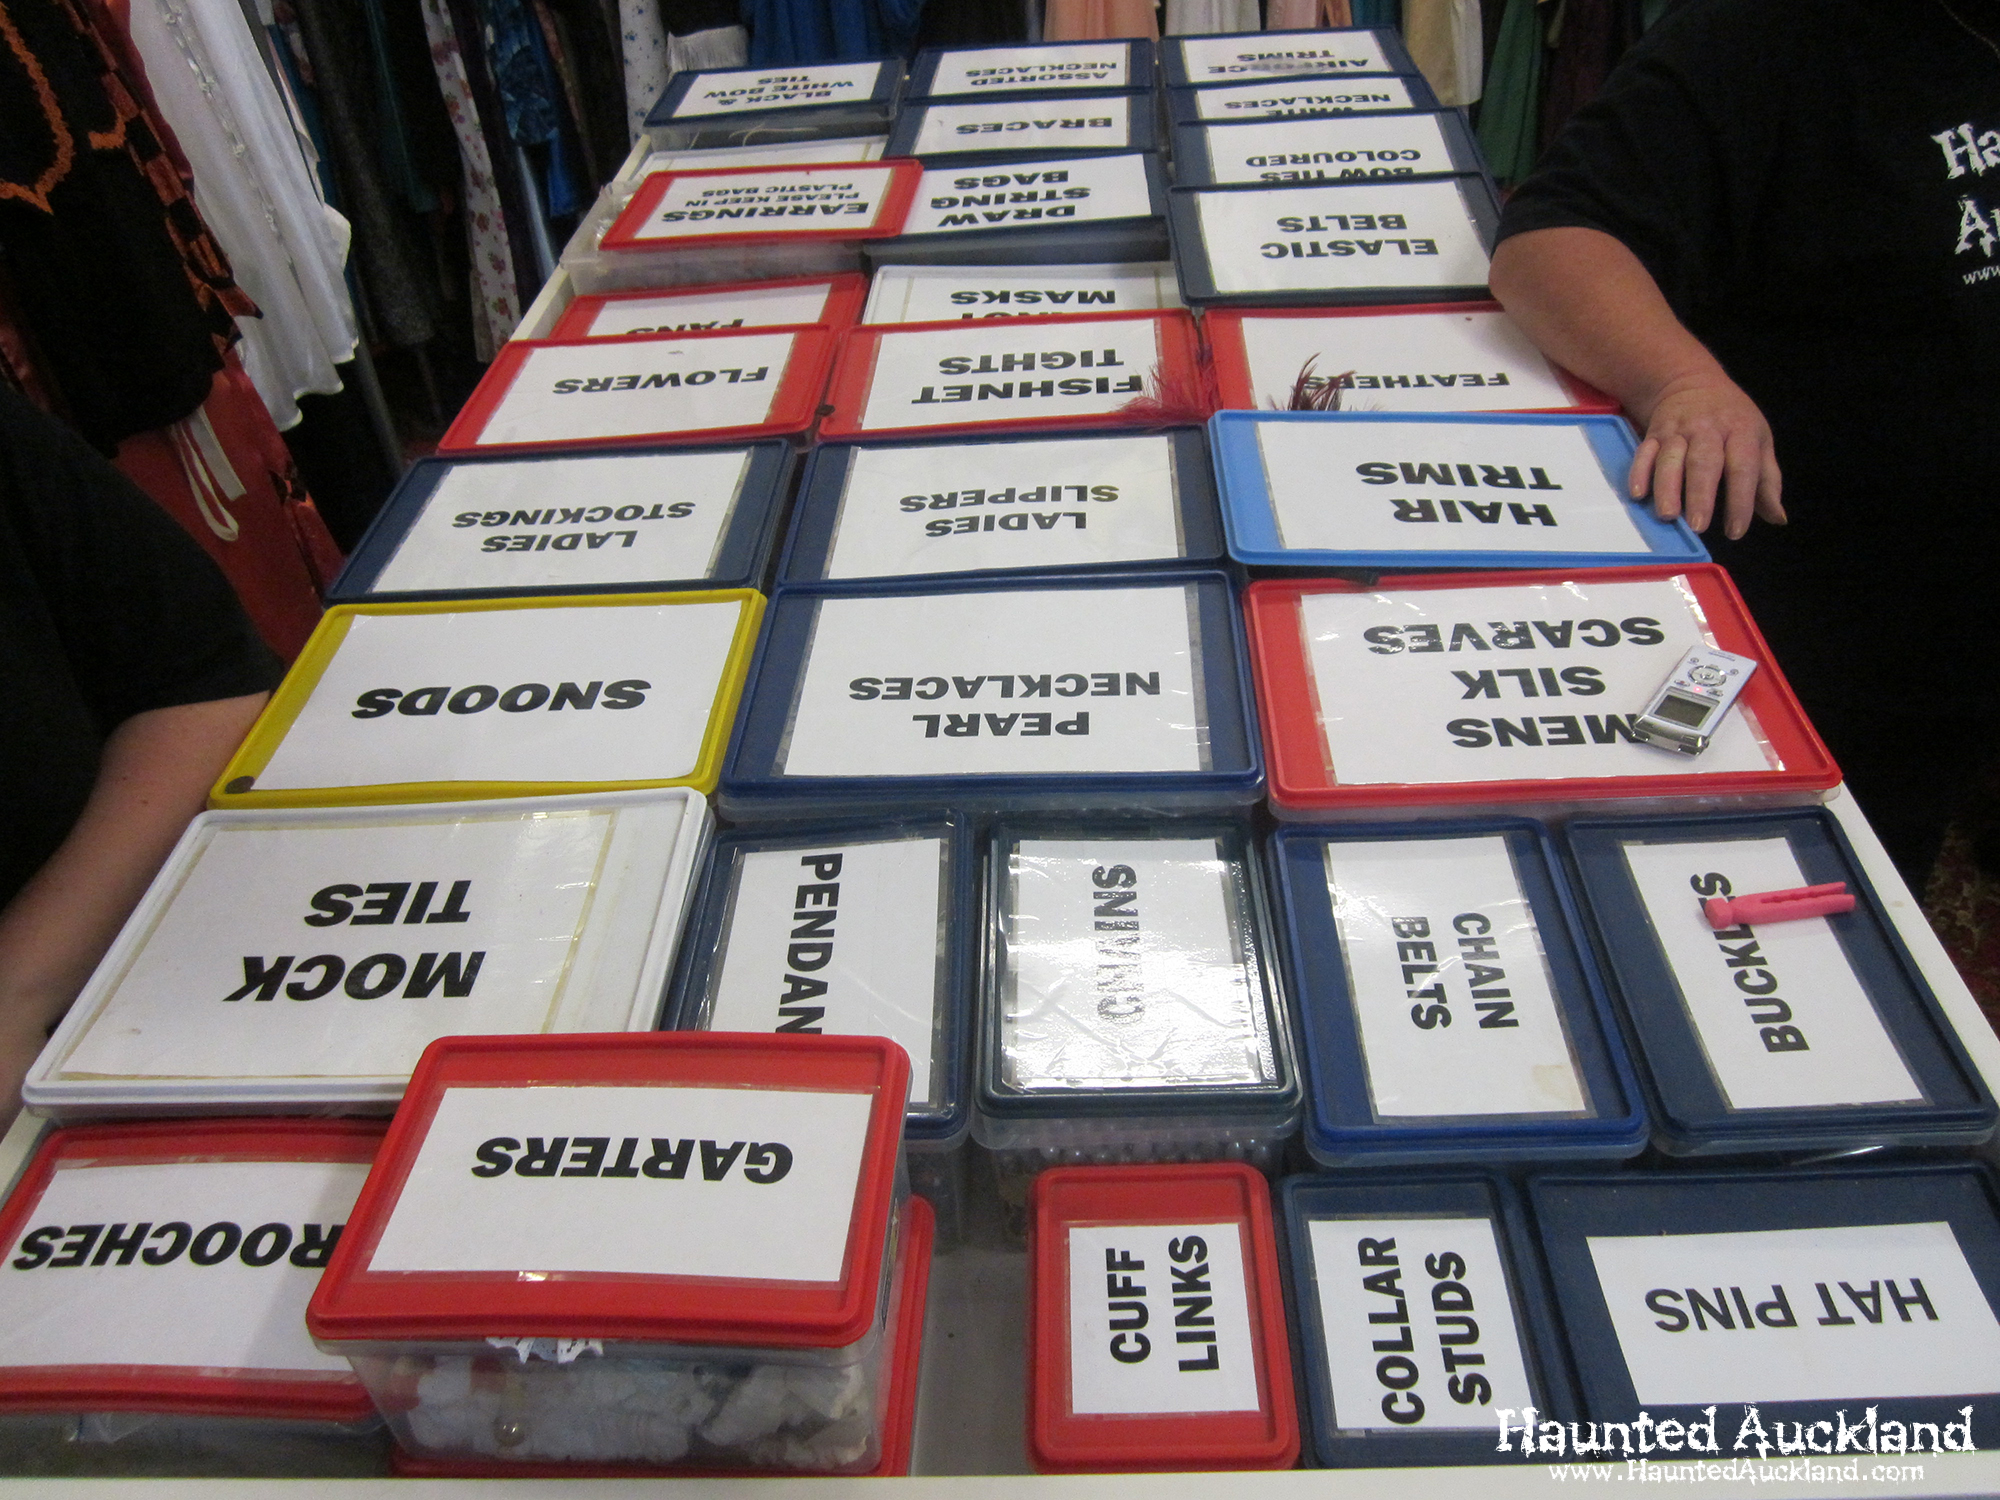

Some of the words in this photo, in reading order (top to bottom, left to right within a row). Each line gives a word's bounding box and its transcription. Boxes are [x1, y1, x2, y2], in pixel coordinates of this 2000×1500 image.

[1207, 58, 1369, 74] AIRCE
[1236, 50, 1335, 62] TRIMS
[757, 75, 810, 86] TIES
[965, 62, 1118, 78] NECKLACES
[970, 71, 1108, 86] ASSORTED
[703, 87, 765, 99] BOW
[745, 89, 832, 104] BLACK
[771, 80, 854, 92] WHITE
[718, 98, 737, 106] &
[1223, 94, 1391, 109] NECKLACES
[955, 117, 1113, 135] BRACES
[1245, 150, 1422, 168] COLOURED
[953, 170, 1069, 190] BAGS
[1259, 170, 1326, 183] TIES
[1339, 167, 1415, 180] BOW
[701, 187, 760, 198] BAGS
[764, 183, 854, 195] PLASTIC
[776, 192, 860, 203] PLEASE
[930, 187, 1091, 210] STRING
[662, 202, 869, 222] EARRINGS
[684, 199, 708, 208] IN
[713, 197, 771, 206] KEEP
[938, 205, 1076, 227] DRAW
[1276, 214, 1408, 233] BELTS
[1260, 238, 1439, 259] ELASTIC
[950, 290, 1117, 305] MASKS
[938, 348, 1125, 376] TIGHTS
[552, 366, 769, 395] FLOWERS
[911, 374, 1143, 405] FISHNET
[1304, 372, 1511, 390] FEATHERS
[1355, 462, 1563, 490] TRIMS
[899, 485, 1120, 513] SLIPPERS
[452, 502, 696, 529] STOCKINGS
[925, 511, 1087, 538] LADIES
[1390, 499, 1558, 527] HAIR
[480, 530, 638, 553] LADIES
[1363, 616, 1665, 655] SCARVES
[848, 671, 1161, 701] NECKLACES
[1450, 666, 1606, 700] SILK
[351, 679, 652, 719] SNOODS
[912, 711, 1090, 738] PEARL
[1446, 713, 1641, 750] MENS
[303, 880, 472, 927] TIES
[222, 951, 486, 1002] MOCK
[1392, 916, 1452, 1030] BELTS
[1452, 912, 1519, 1029] CHAIN
[471, 1136, 794, 1185] GARTERS
[1105, 1247, 1152, 1364] CUFF
[1168, 1235, 1220, 1372] LINKS
[1644, 1284, 1798, 1333] PINS
[1814, 1277, 1939, 1326] HAT
[1357, 1237, 1425, 1425] COLLAR
[1425, 1251, 1492, 1405] STUDS
